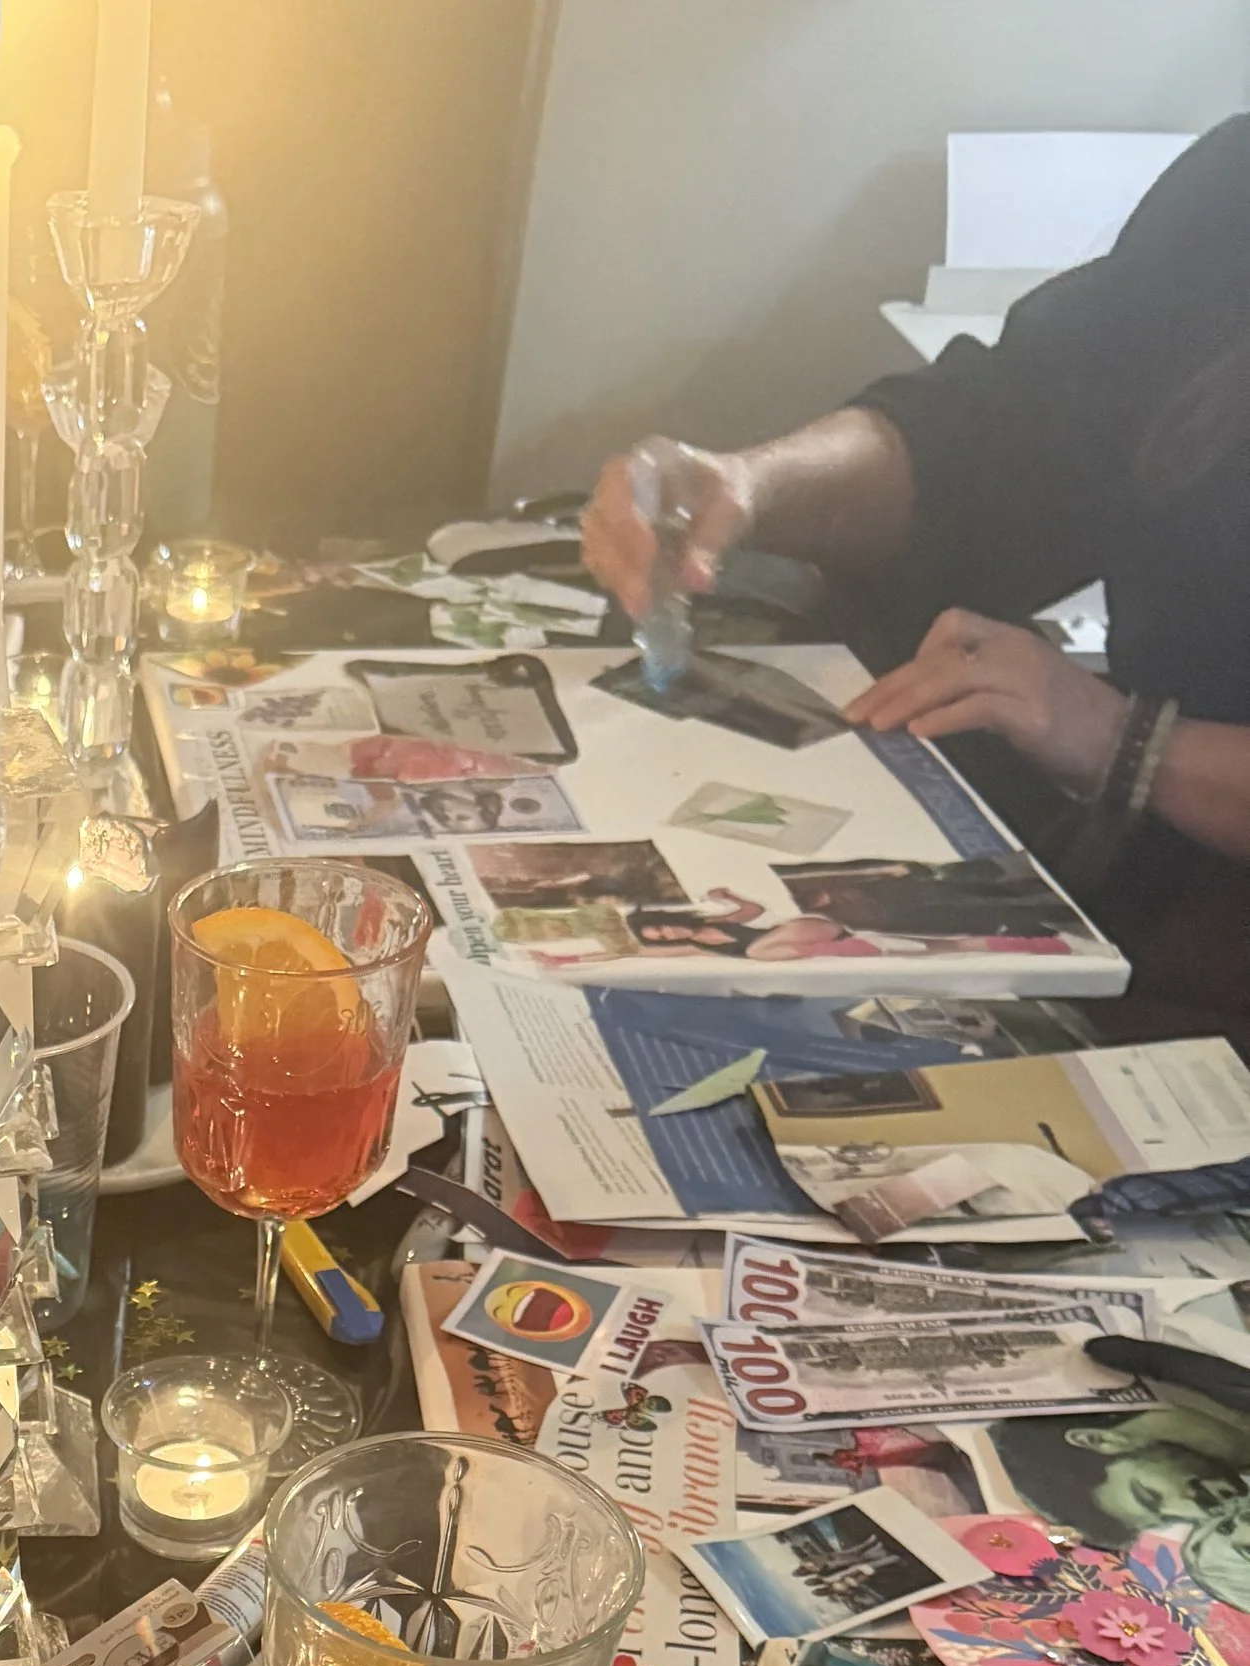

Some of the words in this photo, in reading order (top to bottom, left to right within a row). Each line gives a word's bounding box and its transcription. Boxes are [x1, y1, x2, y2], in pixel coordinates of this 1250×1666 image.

[429, 850, 463, 887] heart
[448, 889, 485, 923] your
[606, 1296, 664, 1363] LAUGH
[599, 1362, 628, 1375] I
[721, 1335, 808, 1417] 100
[555, 1392, 595, 1472] ouse
[667, 1397, 736, 1537] ibrancy
